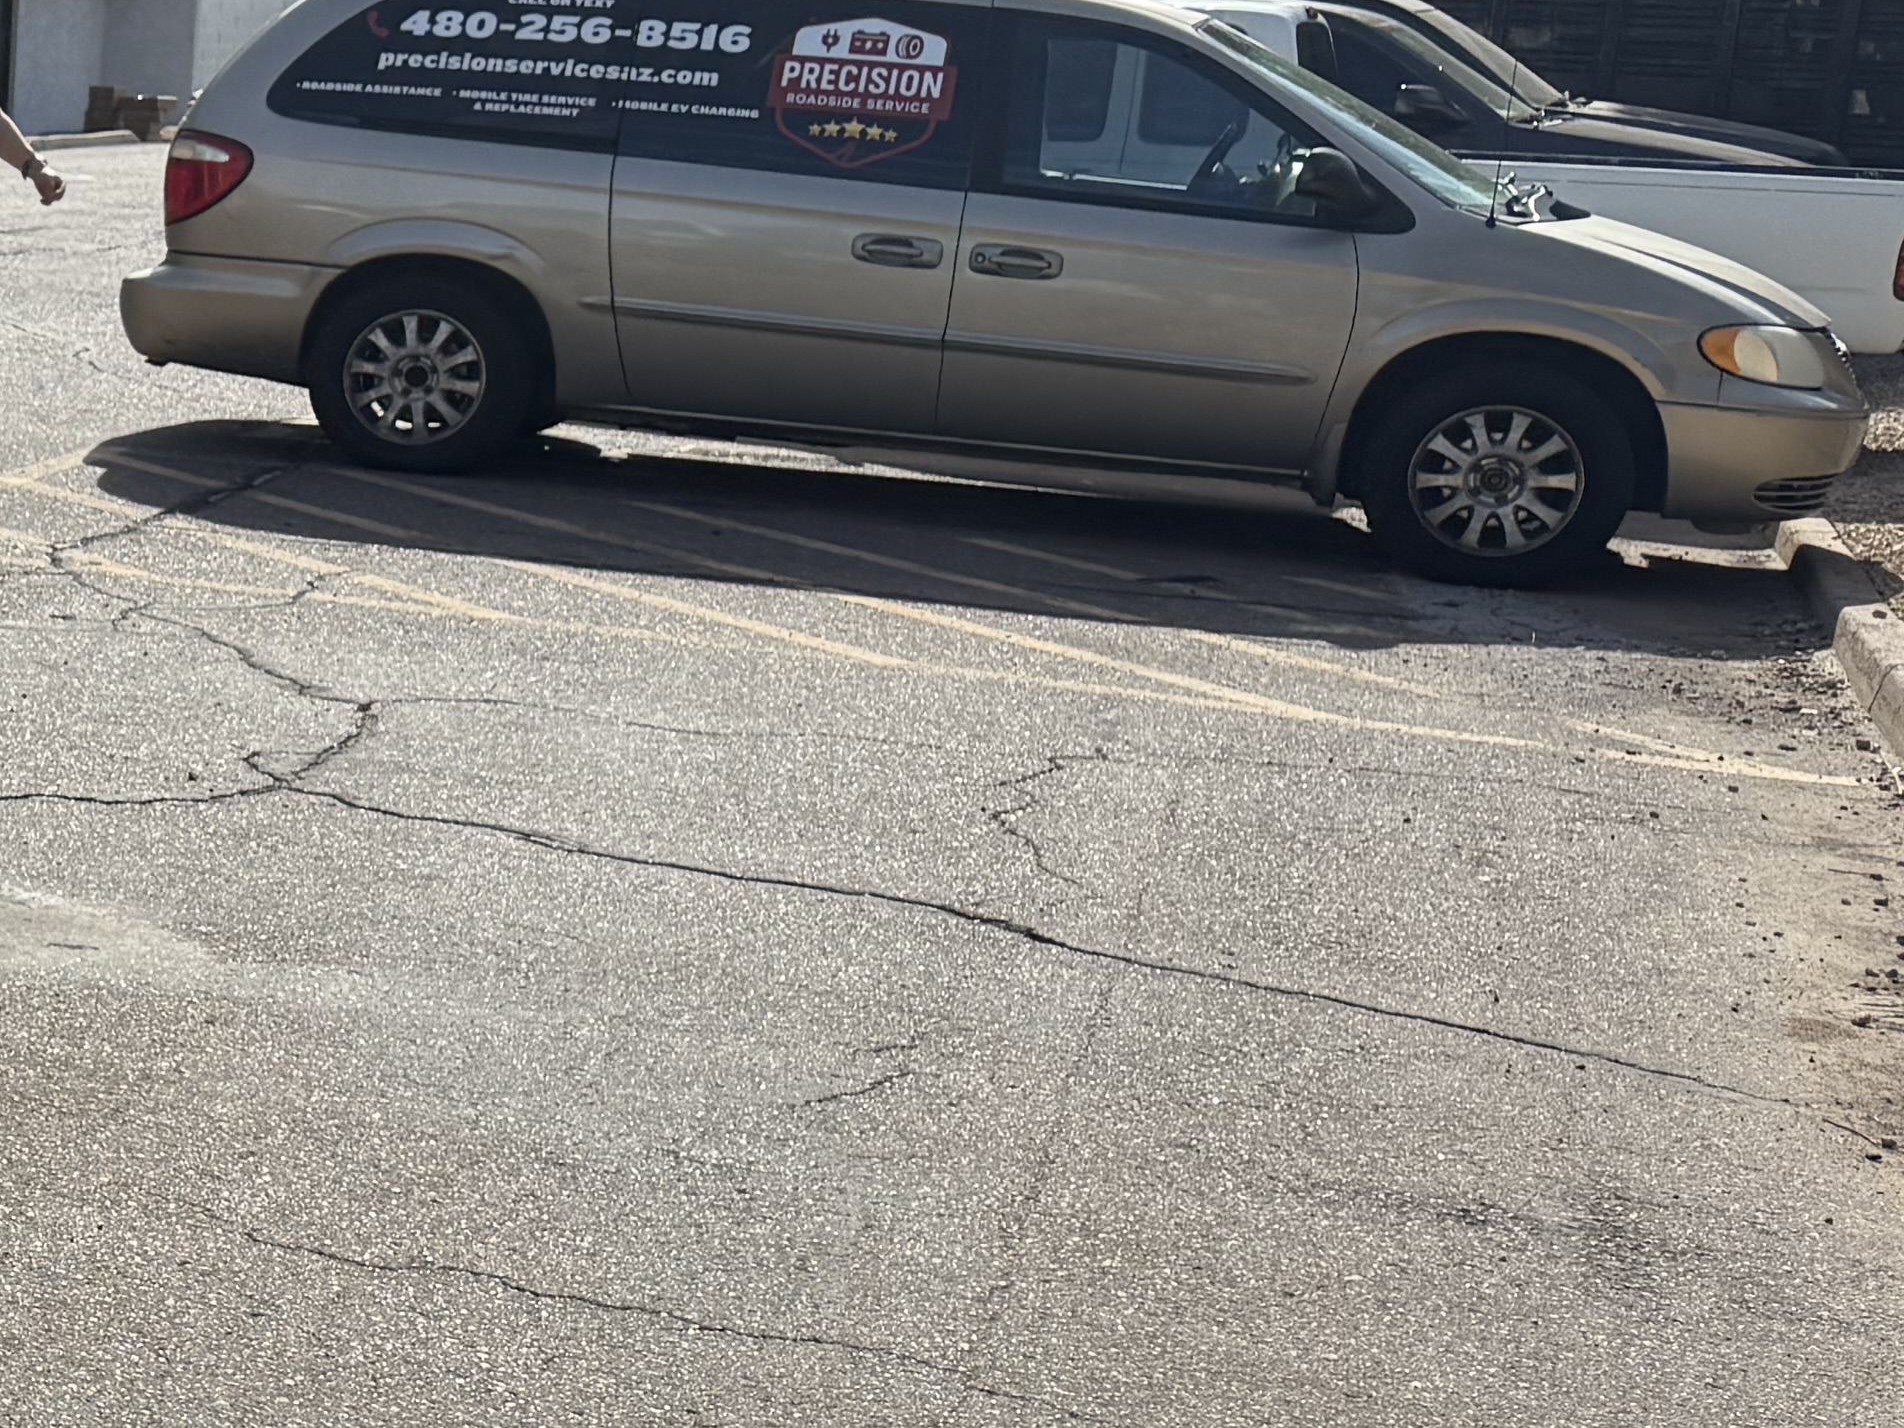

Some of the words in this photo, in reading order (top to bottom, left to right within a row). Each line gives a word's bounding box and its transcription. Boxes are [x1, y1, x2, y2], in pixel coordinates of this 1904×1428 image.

[399, 9, 753, 53] 480-256-8516
[377, 51, 720, 87] precisionservicesaz.com
[301, 80, 363, 93] ROADSIDE
[365, 83, 442, 97] ASSISTANCE
[780, 60, 944, 98] PRECISION
[458, 89, 508, 101] MOBILE
[510, 91, 539, 103] TIRE
[542, 94, 597, 107] SERVICE
[786, 93, 862, 109] ROADSIDE
[866, 98, 930, 114] SERVICE
[484, 102, 580, 117] REPLACEMENT
[671, 103, 689, 114] EV
[691, 106, 760, 119] CHARGING
